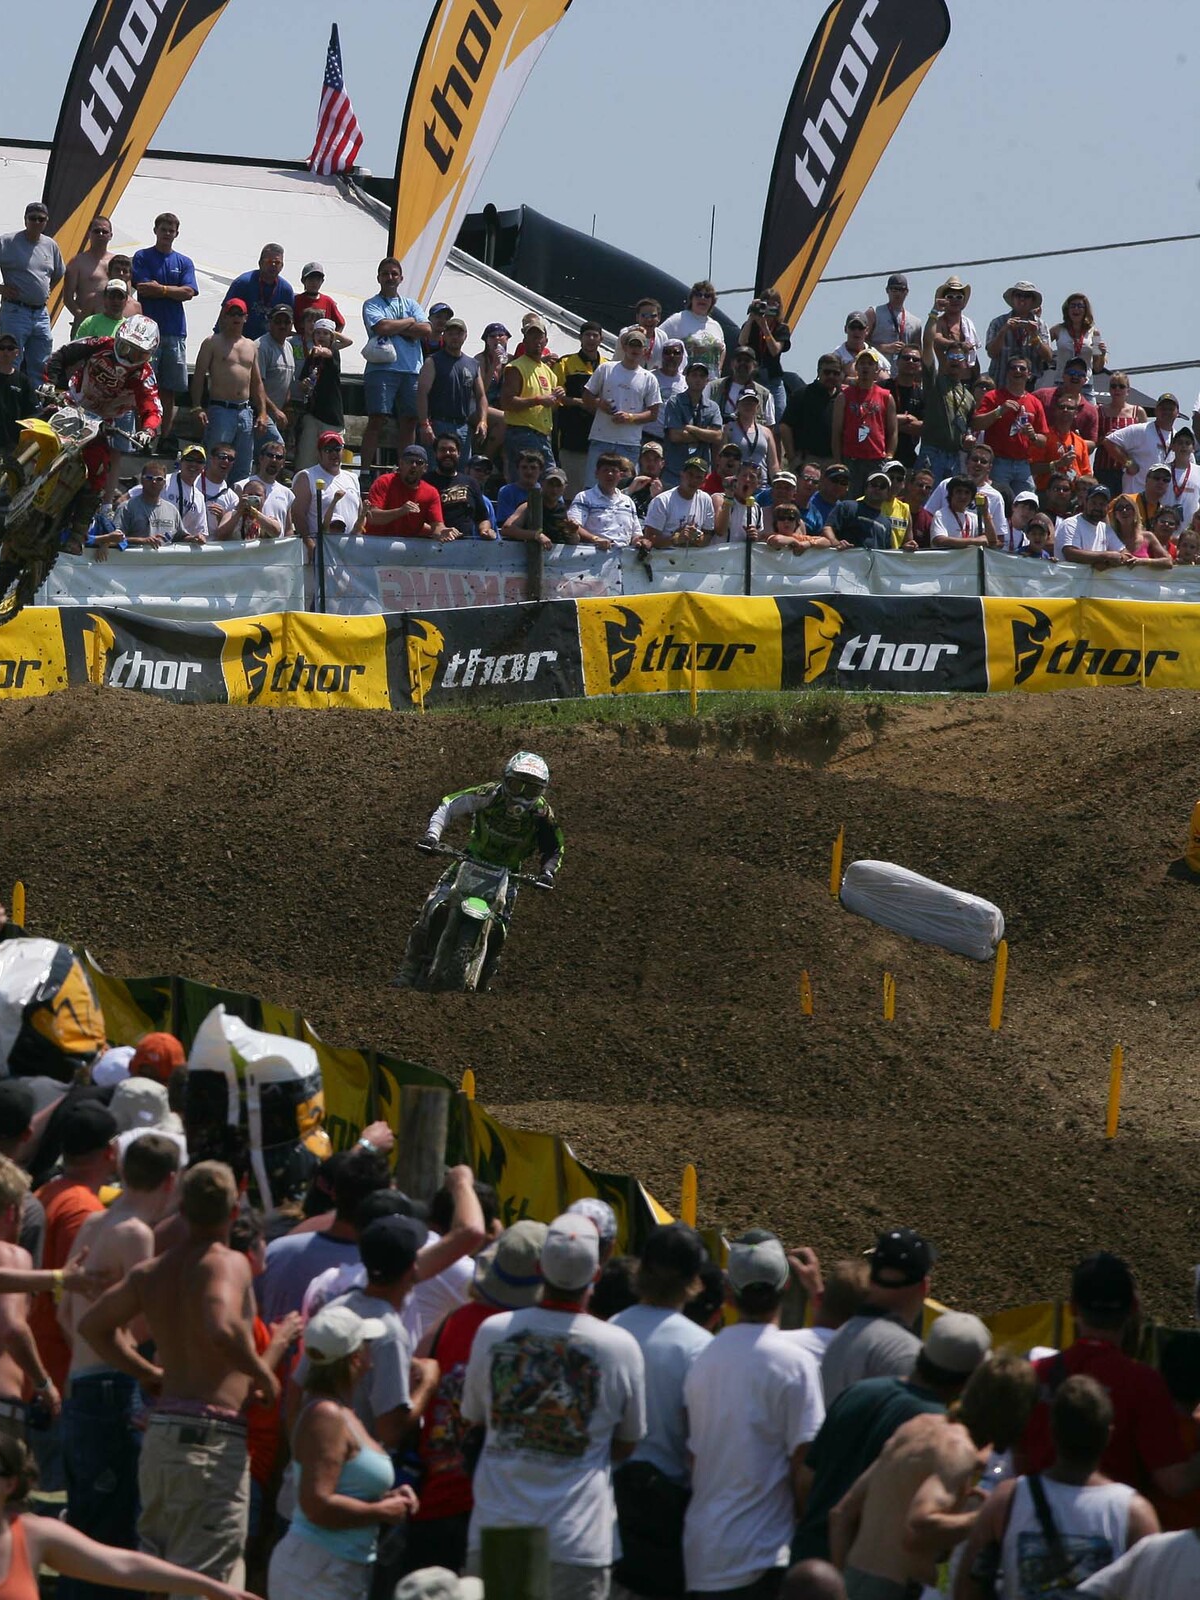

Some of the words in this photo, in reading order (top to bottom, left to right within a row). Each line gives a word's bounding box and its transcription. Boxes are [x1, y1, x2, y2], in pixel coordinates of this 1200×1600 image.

[80, 0, 167, 156] tho
[795, 0, 879, 208] thor
[109, 651, 202, 690] thor
[270, 652, 365, 692] thor
[441, 648, 559, 689] thor
[640, 634, 756, 672] thor
[838, 634, 959, 671] thor
[1046, 639, 1180, 677] thor
